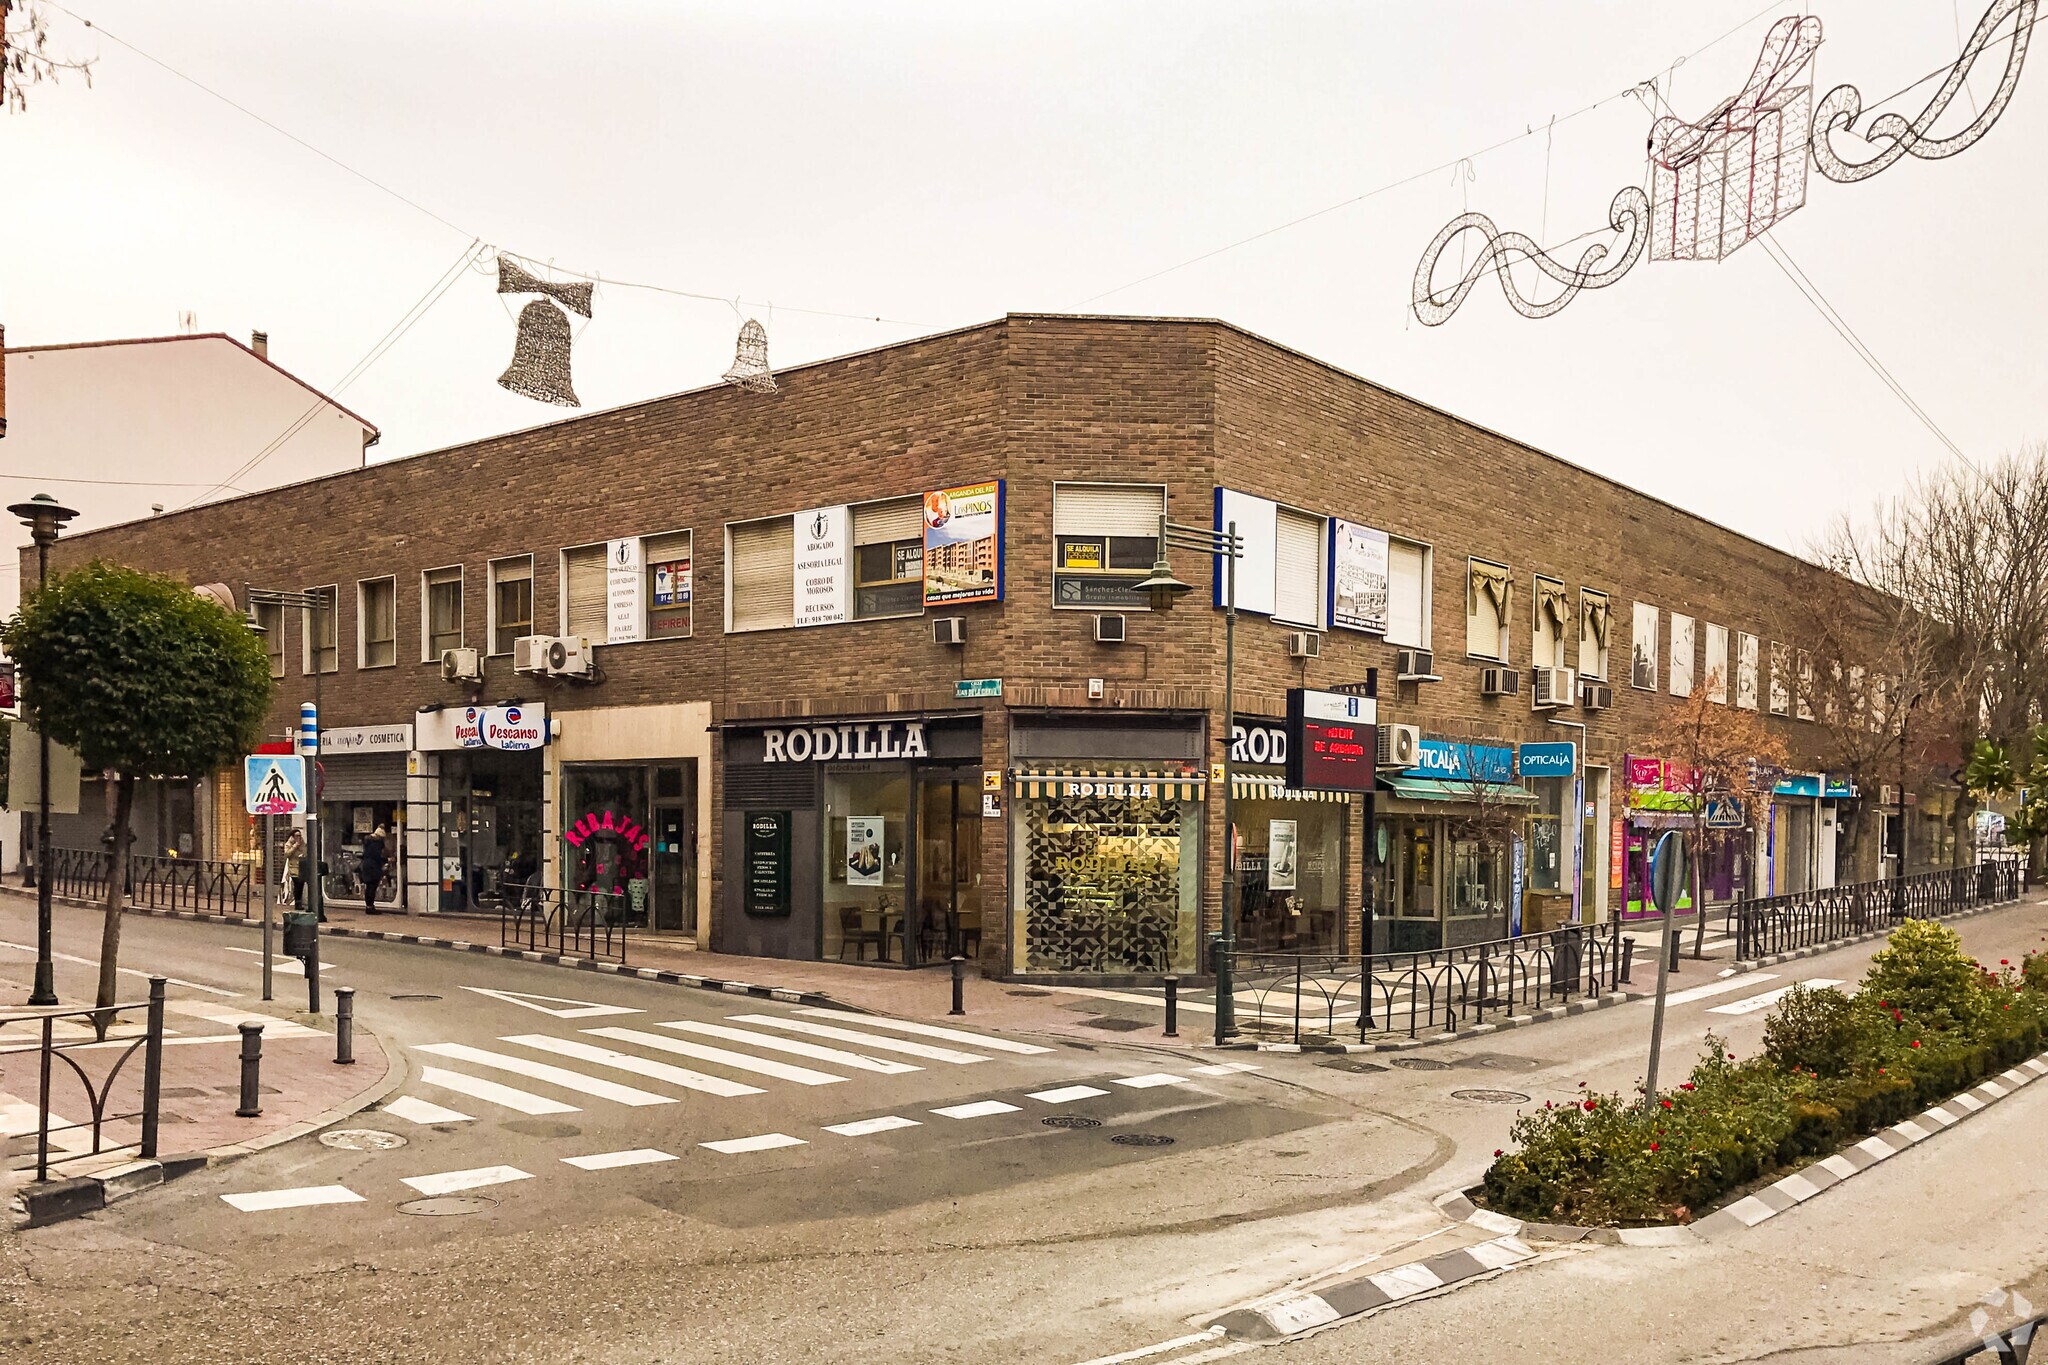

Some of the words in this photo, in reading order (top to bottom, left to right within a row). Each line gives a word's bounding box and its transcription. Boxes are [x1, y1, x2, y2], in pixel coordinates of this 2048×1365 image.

[948, 488, 975, 500] ARGANDA
[975, 487, 985, 495] DEL
[986, 485, 995, 493] REY
[806, 541, 834, 552] ABOGADO
[897, 550, 905, 561] SE
[824, 557, 843, 567] LEGAL
[806, 578, 826, 587] COBRO
[826, 576, 834, 584] DE
[806, 586, 834, 595] MOROSOS
[806, 604, 835, 613] RECURSOS
[490, 724, 538, 740] Descanso
[370, 733, 405, 744] COSMETICA
[763, 722, 928, 763] RODILLA
[1068, 784, 1153, 798] RODILLA
[564, 810, 650, 852] REBAJAS
